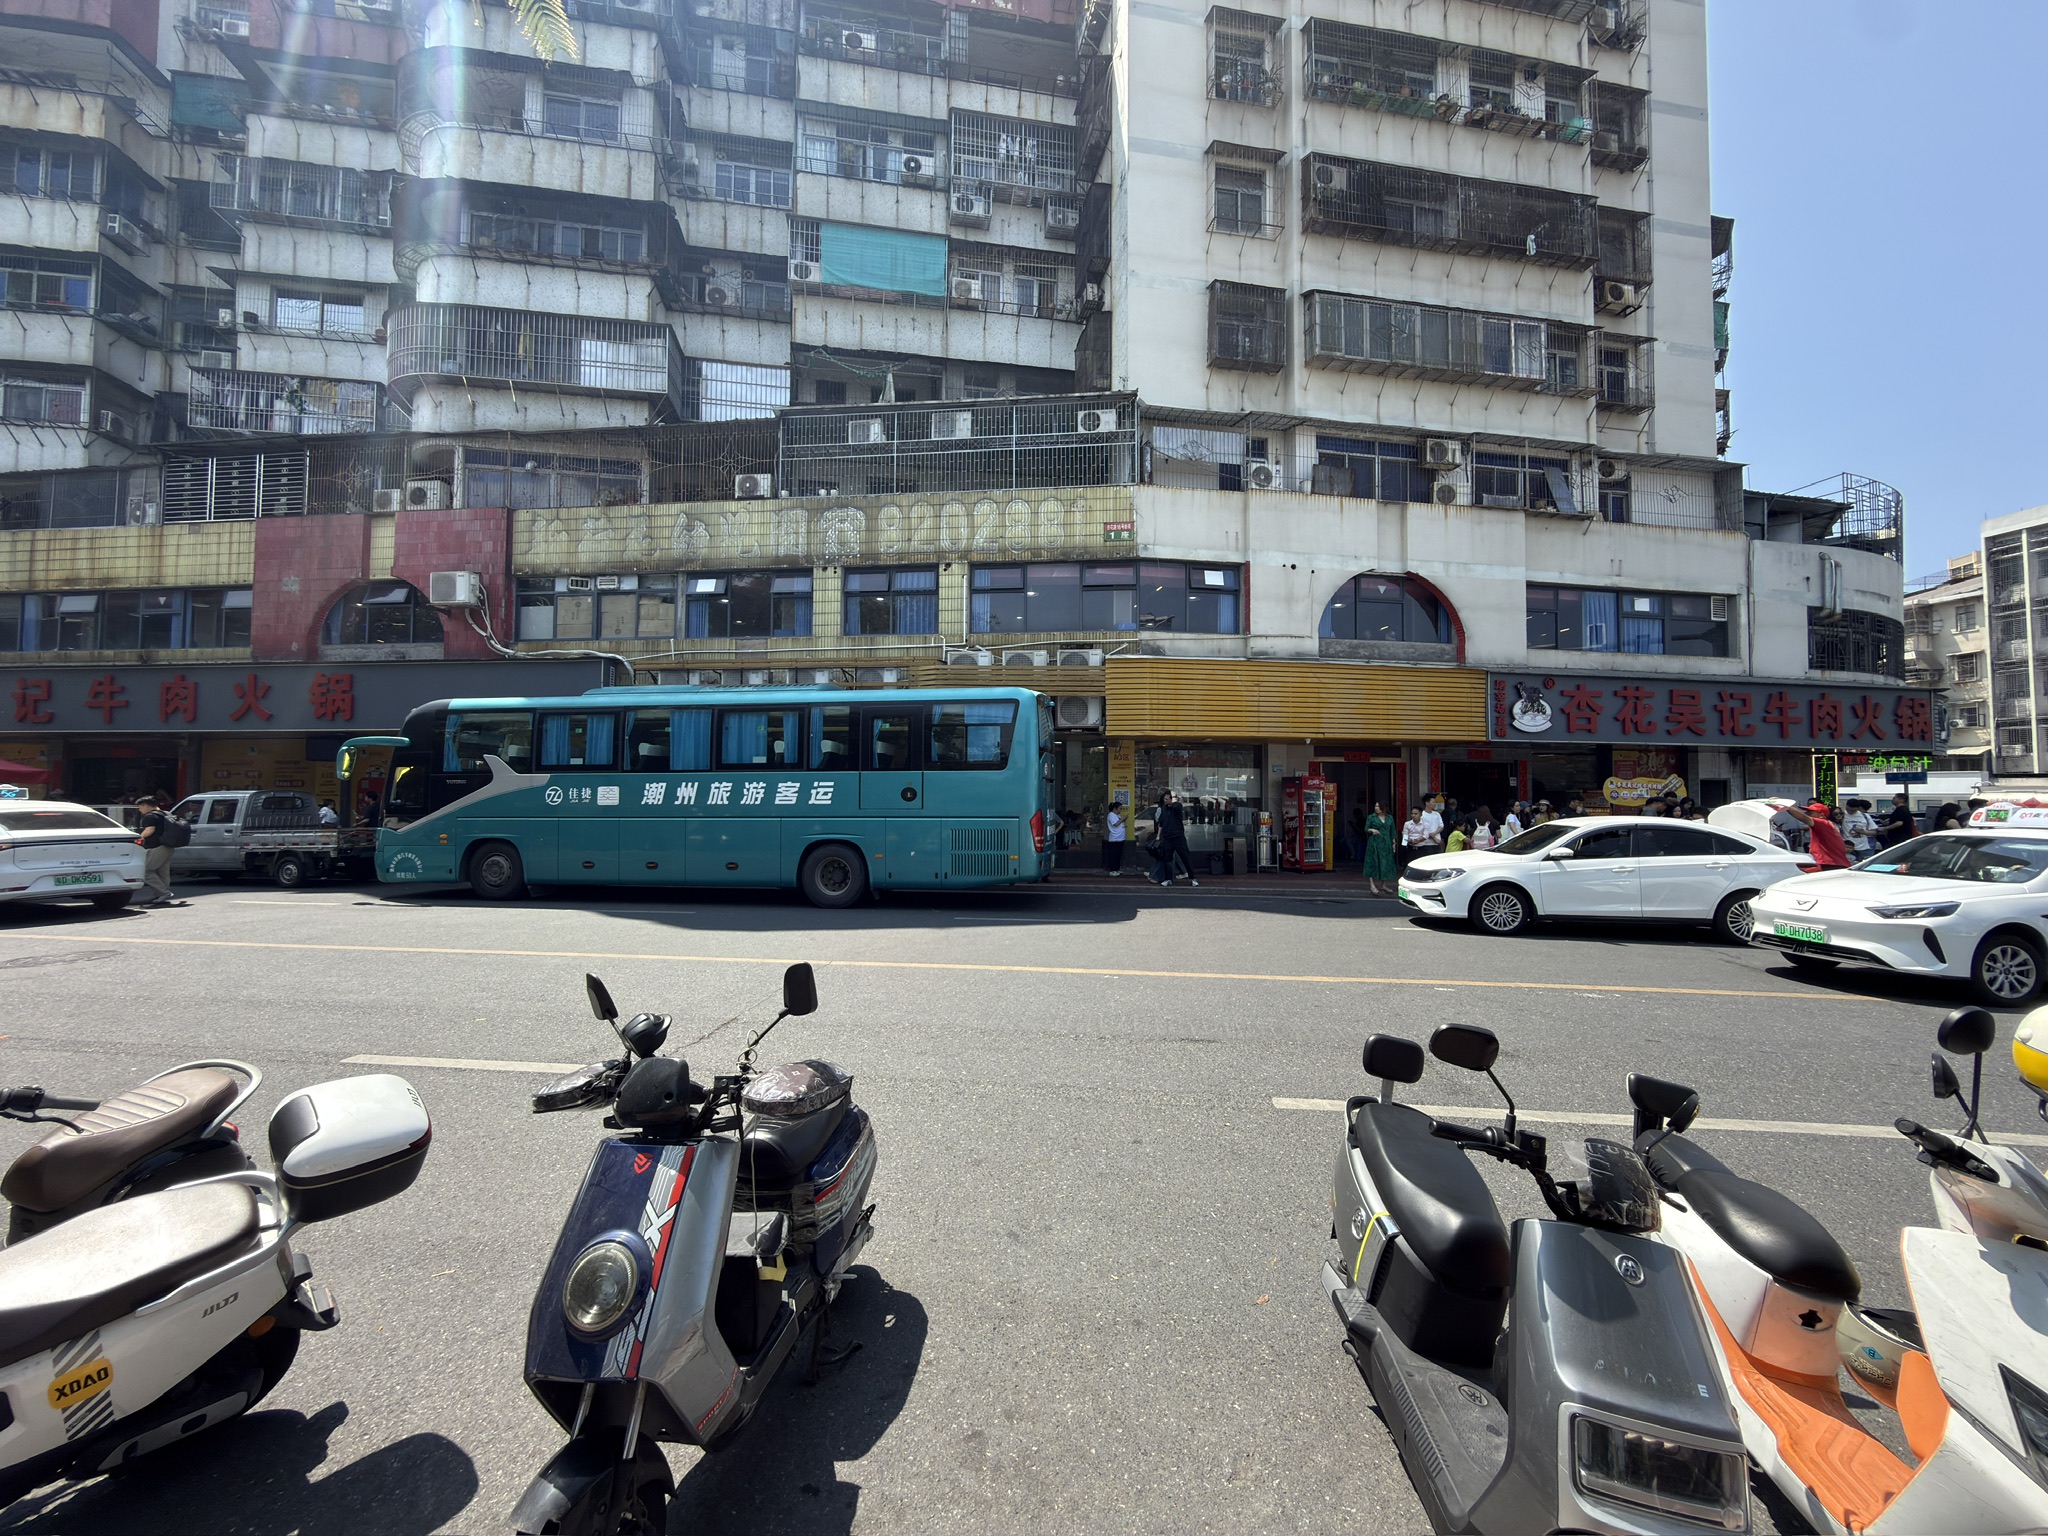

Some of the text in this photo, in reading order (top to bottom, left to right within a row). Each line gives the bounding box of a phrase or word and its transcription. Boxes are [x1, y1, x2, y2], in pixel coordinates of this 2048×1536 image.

[12, 674, 356, 724] 记牛肉火锅
[1561, 683, 1932, 743] 杏花吴记牛肉火锅
[568, 786, 592, 800] 佳捷
[641, 781, 836, 806] 潮州旅游客运
[54, 1366, 110, 1402] XDAO
